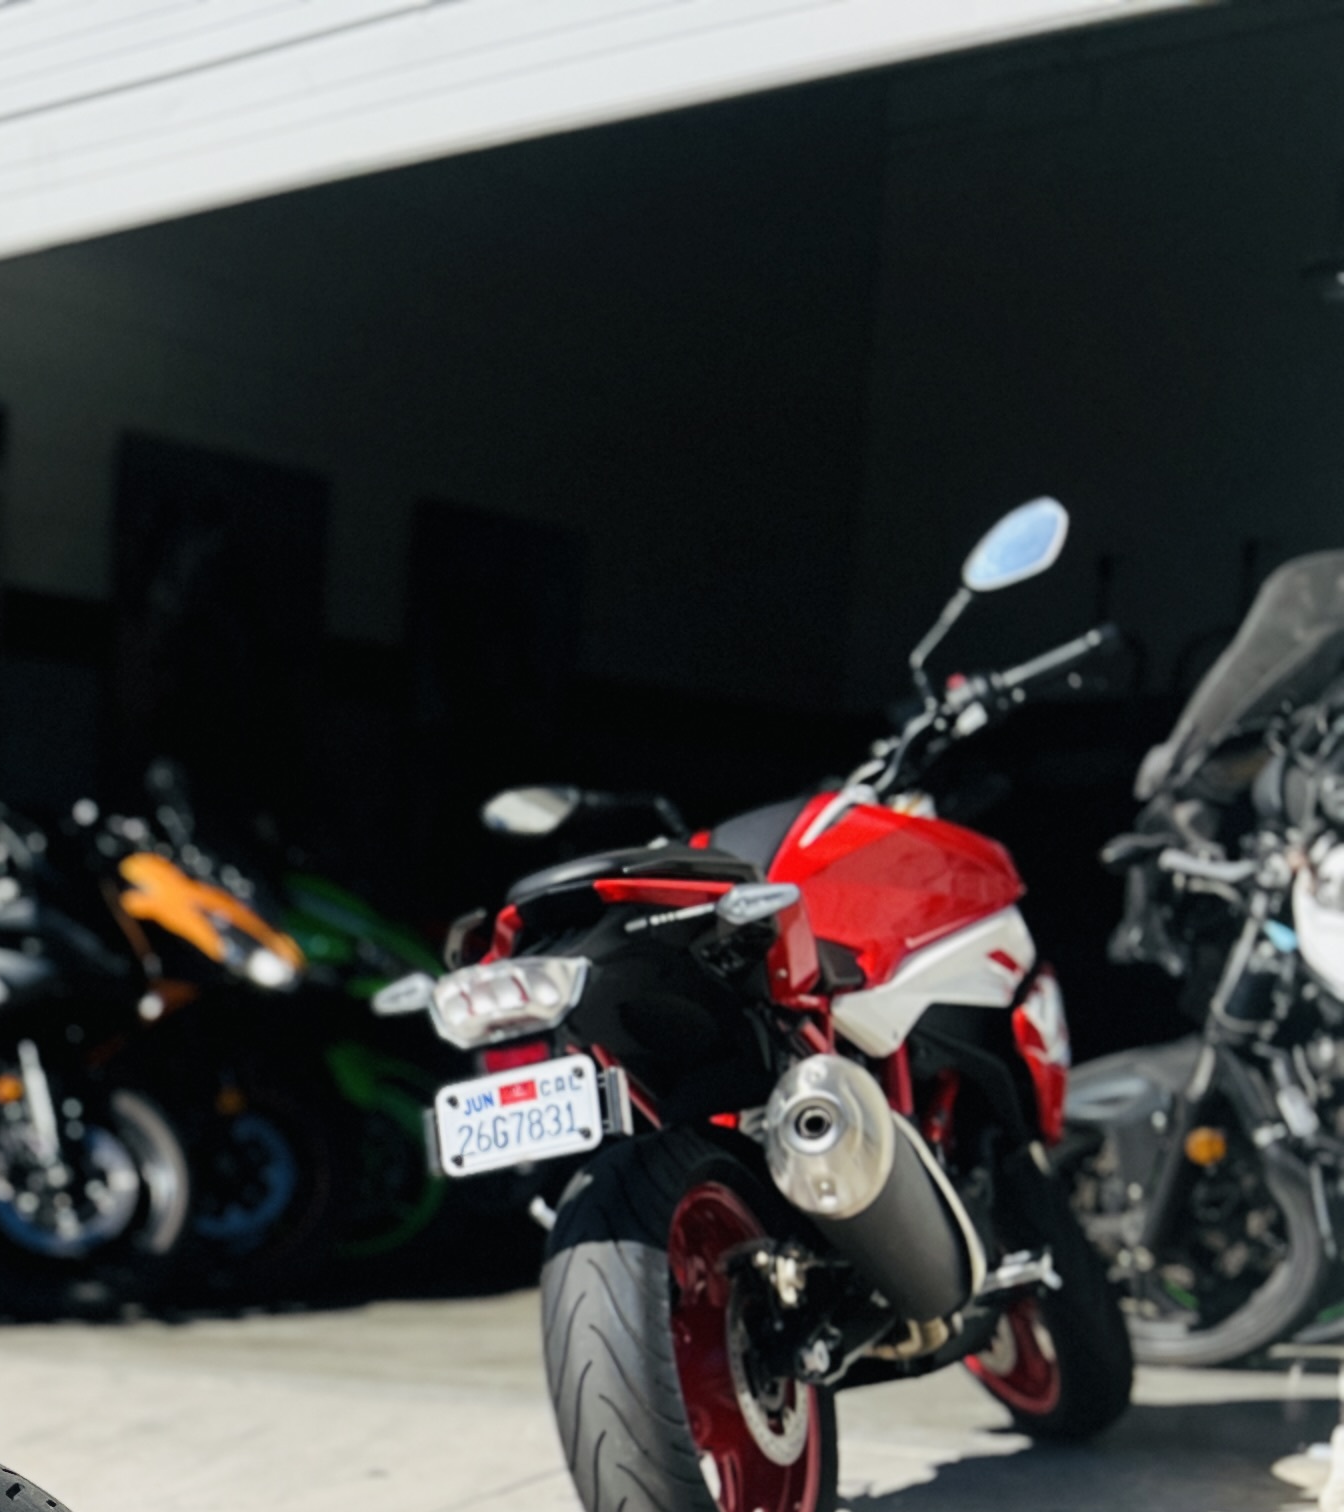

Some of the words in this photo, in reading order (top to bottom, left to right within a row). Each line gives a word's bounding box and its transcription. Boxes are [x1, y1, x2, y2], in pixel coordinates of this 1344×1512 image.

[539, 1074, 582, 1097] CAL
[463, 1091, 495, 1116] JUN
[458, 1101, 581, 1158] 26G7831
